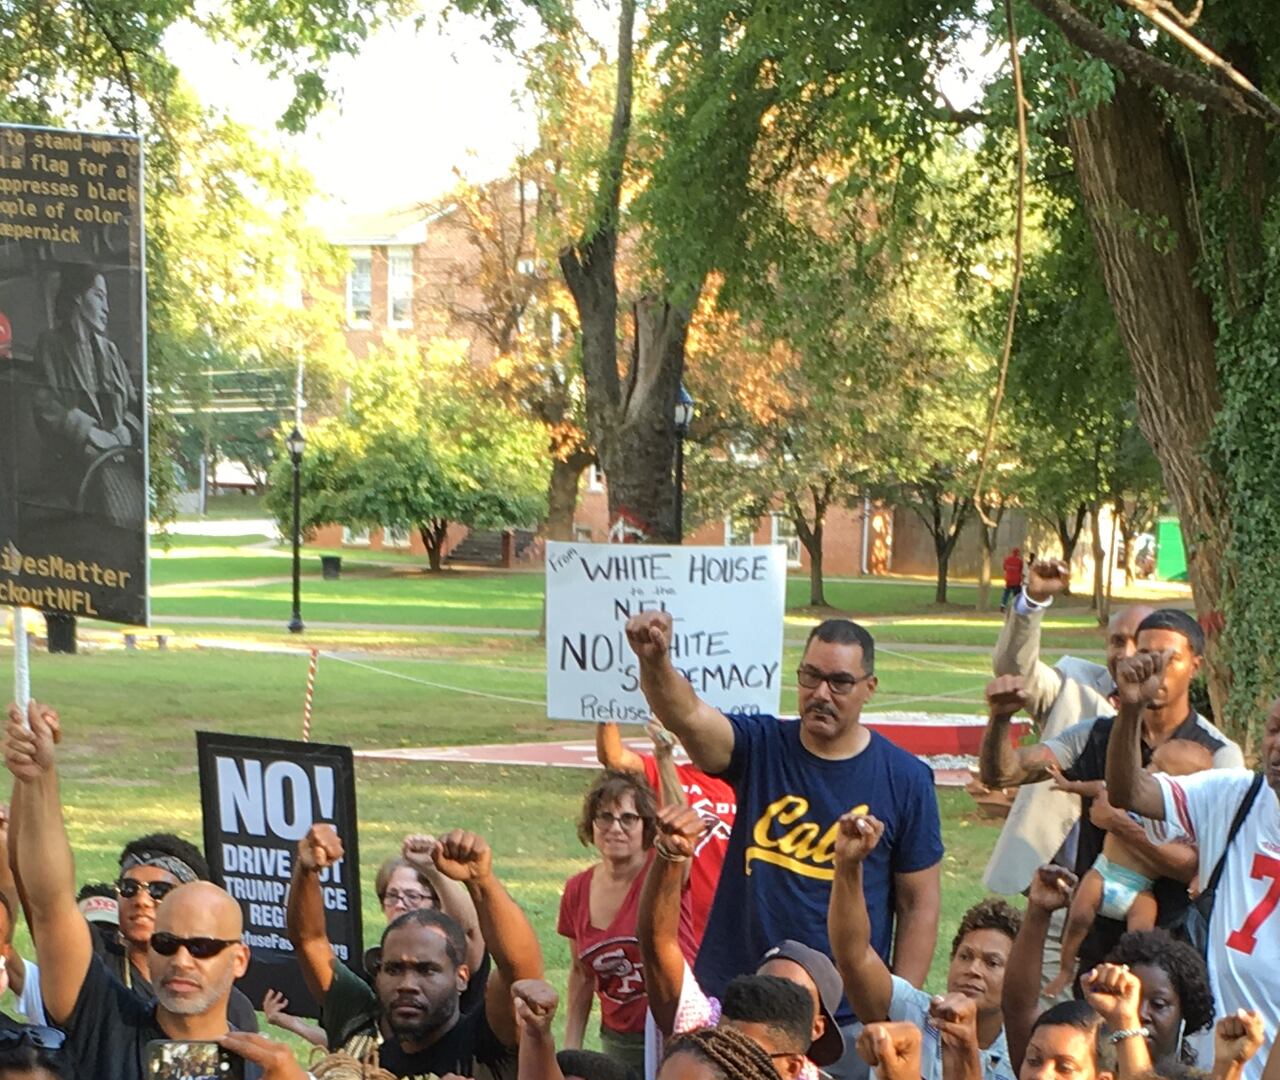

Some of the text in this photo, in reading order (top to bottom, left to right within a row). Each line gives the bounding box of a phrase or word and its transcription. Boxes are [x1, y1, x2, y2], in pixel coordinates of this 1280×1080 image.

[7, 130, 25, 147] to
[34, 132, 82, 152] stand
[91, 139, 112, 155] up
[122, 138, 139, 156] to
[10, 155, 22, 169] a
[31, 155, 69, 176] flag
[78, 160, 107, 177] for
[116, 165, 127, 178] a
[87, 181, 137, 203] black
[45, 202, 65, 220] of
[74, 205, 130, 226] color.
[548, 547, 578, 574] From
[580, 554, 768, 586] WHITE HOUSE
[669, 631, 731, 660] HITE
[619, 661, 779, 694] SEMACY
[215, 756, 337, 841] NO!
[223, 843, 291, 879] DRIVE
[249, 903, 288, 929] REG
